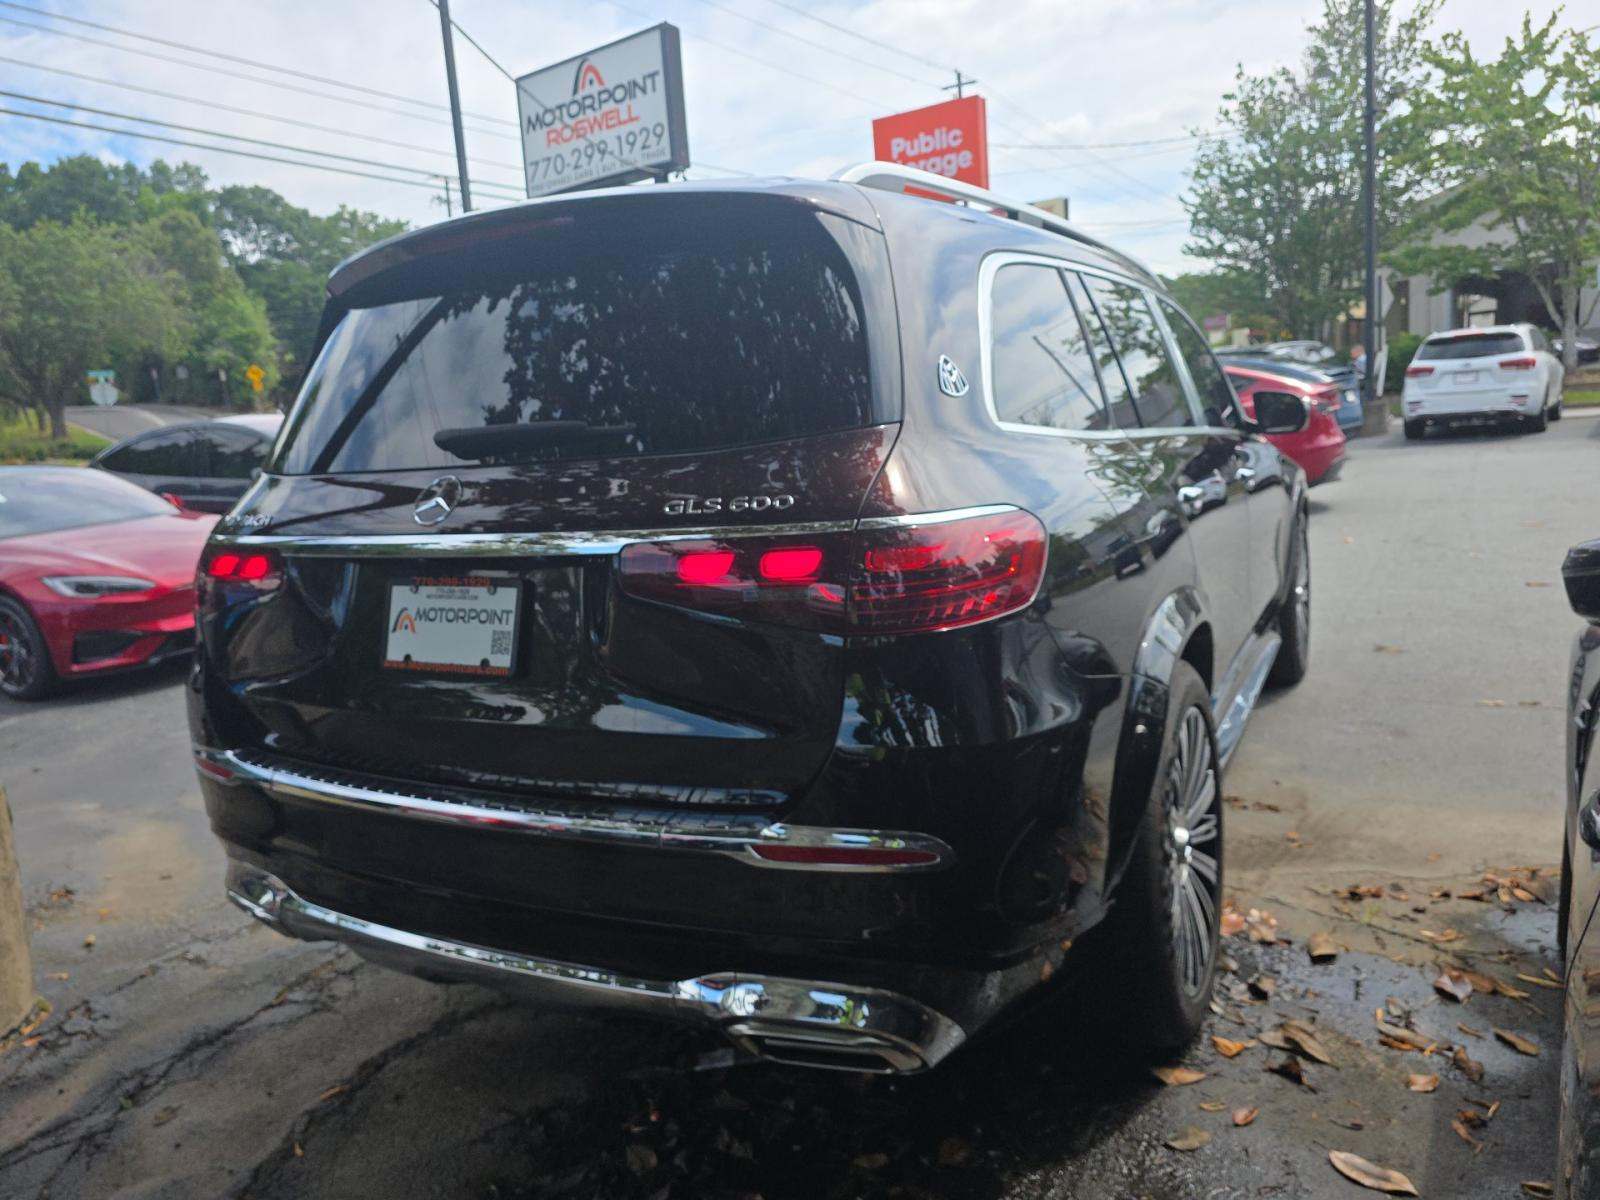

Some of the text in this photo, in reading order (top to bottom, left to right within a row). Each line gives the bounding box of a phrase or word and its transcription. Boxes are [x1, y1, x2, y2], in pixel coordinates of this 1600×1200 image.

[526, 70, 660, 134] MOTORPOINT
[546, 104, 641, 147] ROSWELL
[890, 128, 963, 160] Public
[664, 494, 795, 515] GLS 600
[414, 607, 513, 625] MOTORPOINT
